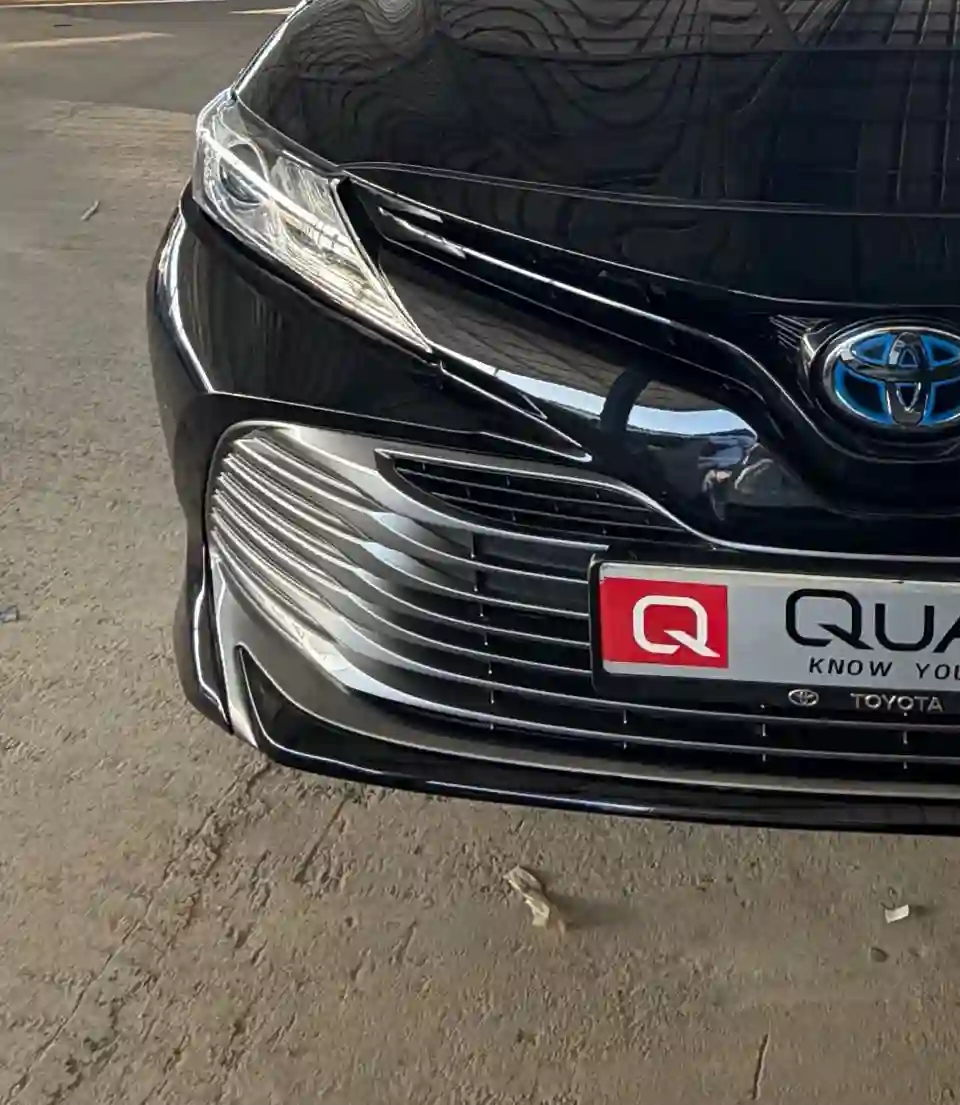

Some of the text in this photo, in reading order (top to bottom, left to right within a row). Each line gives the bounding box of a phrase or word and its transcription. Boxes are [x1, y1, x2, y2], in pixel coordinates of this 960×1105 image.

[632, 595, 720, 658] Q
[809, 657, 893, 677] KNOW
[850, 693, 944, 713] TOYOTA
